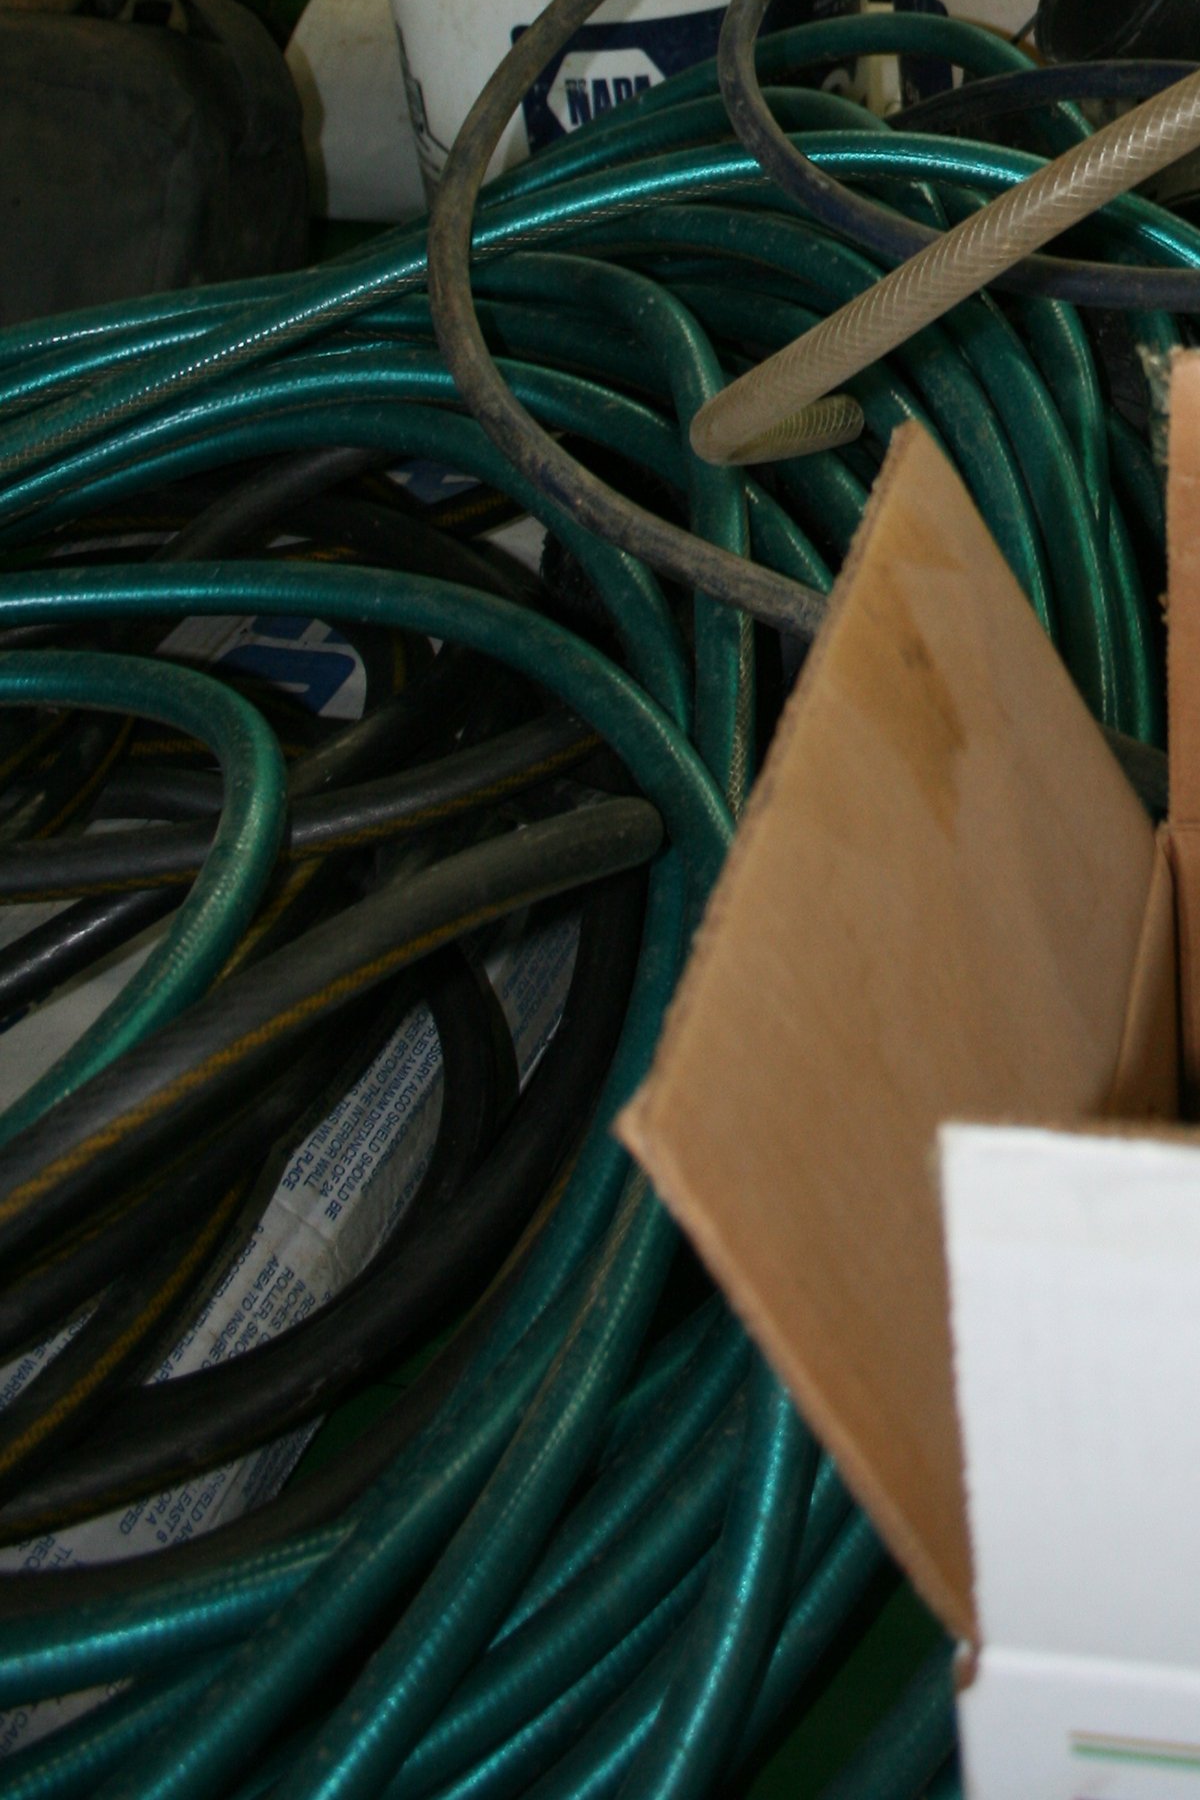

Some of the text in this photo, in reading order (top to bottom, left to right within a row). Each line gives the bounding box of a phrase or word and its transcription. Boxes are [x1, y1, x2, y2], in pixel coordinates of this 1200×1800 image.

[375, 1040, 408, 1083] BEYOND
[360, 1083, 380, 1106] THE
[375, 1063, 411, 1110] MINIMUM
[393, 1081, 419, 1112] ALCO
[308, 1123, 331, 1152] WILL
[325, 1105, 365, 1158] INTERIOR
[339, 1109, 381, 1164] DISTANCE
[367, 1111, 400, 1153] SHIELD
[282, 1151, 313, 1190] PLACE
[304, 1158, 330, 1189] WALL
[328, 1164, 345, 1182] OF
[335, 1152, 374, 1201] SHOULD
[319, 1182, 333, 1197] 24
[324, 1200, 342, 1219] BE
[253, 1256, 281, 1291] AREA
[240, 1291, 258, 1311] TO
[253, 1267, 295, 1321] ROLLER,
[268, 1280, 306, 1330] INCHES.
[188, 1300, 214, 1333] WITH
[170, 1333, 193, 1360] THE
[208, 1310, 245, 1358] INSURE
[145, 1512, 158, 1525] A
